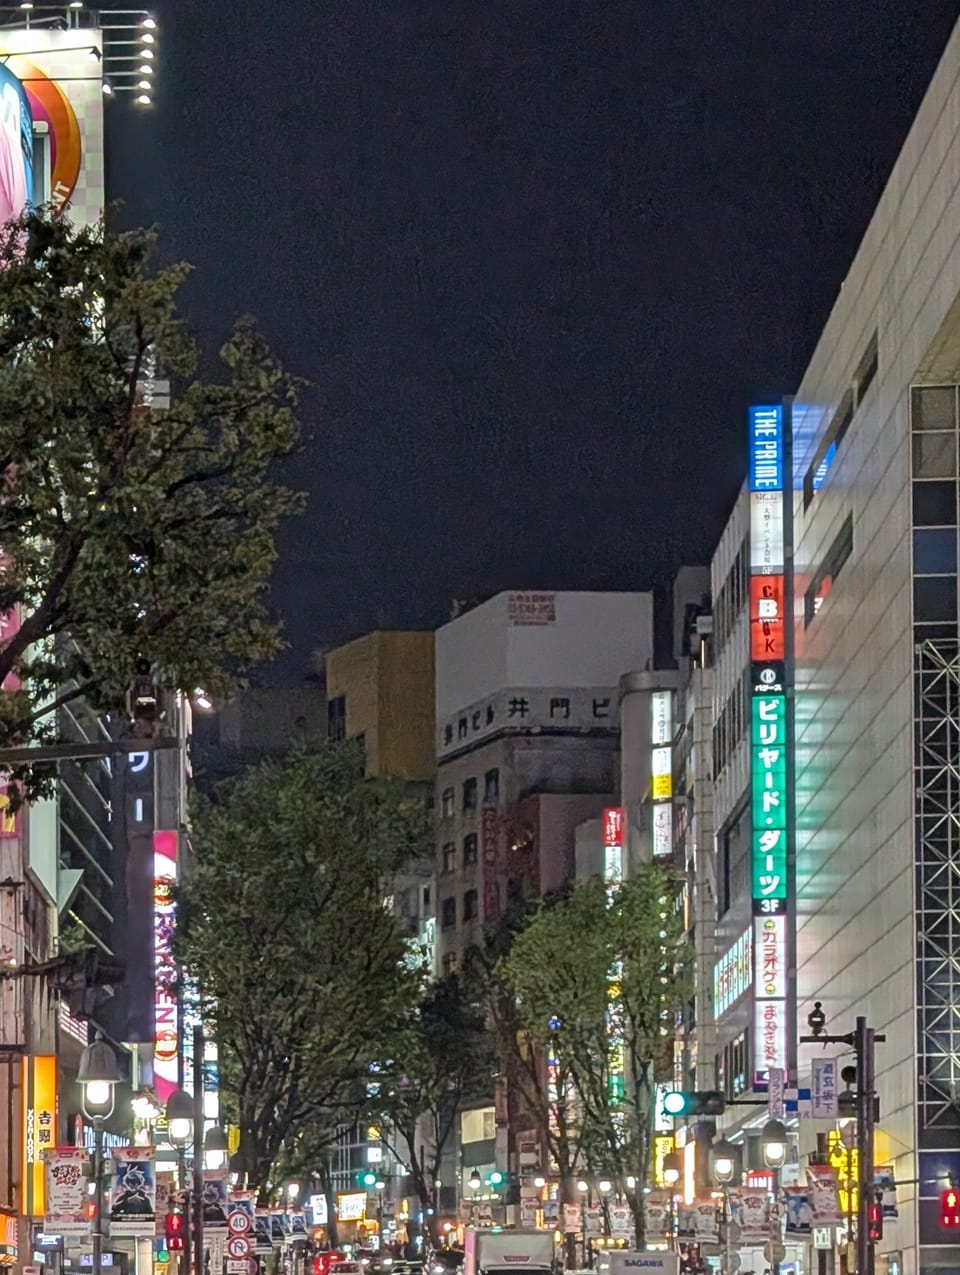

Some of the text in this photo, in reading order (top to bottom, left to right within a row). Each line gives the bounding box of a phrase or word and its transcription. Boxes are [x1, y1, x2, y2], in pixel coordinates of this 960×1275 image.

[755, 409, 777, 437] THE
[755, 441, 777, 487] PRIME
[761, 901, 778, 912] 3F
[762, 931, 777, 983] カラオケ
[763, 1005, 777, 1061] まねきね
[233, 1218, 245, 1228] 40
[624, 1259, 664, 1267] SAGAWA
